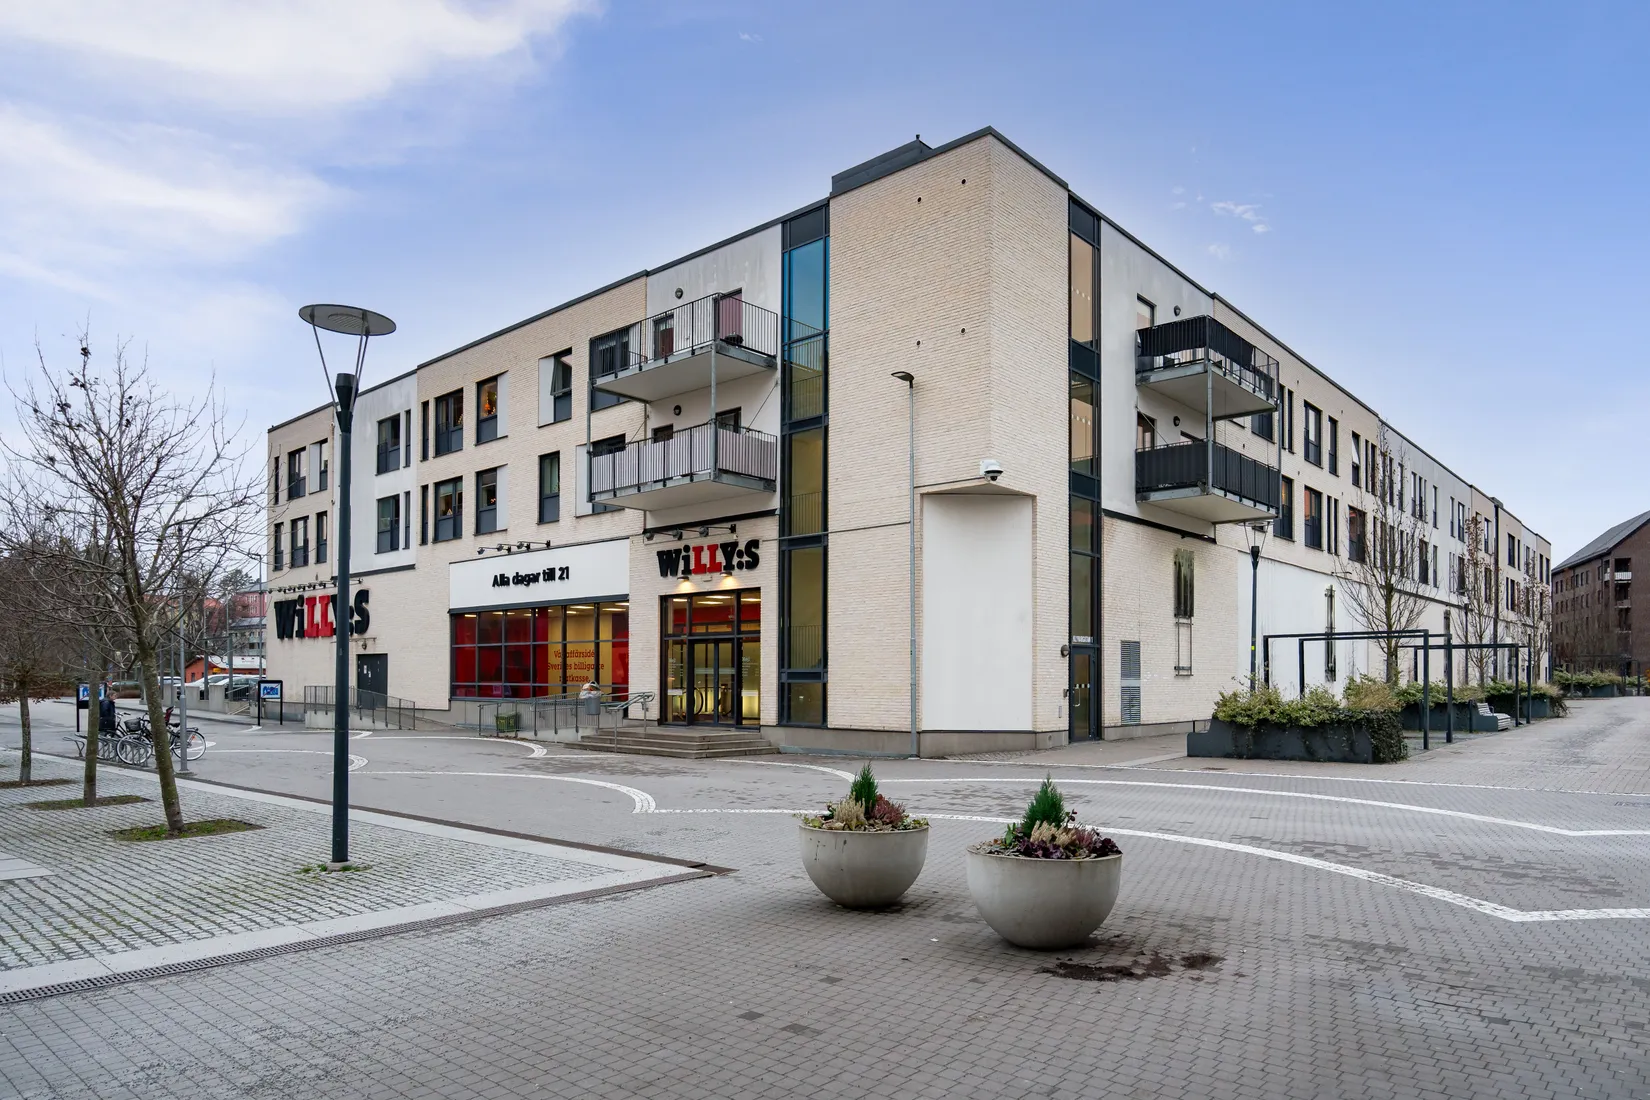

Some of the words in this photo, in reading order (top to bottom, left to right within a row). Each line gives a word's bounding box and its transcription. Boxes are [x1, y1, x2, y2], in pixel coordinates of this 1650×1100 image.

[492, 573, 510, 587] Alla
[512, 571, 541, 587] dagar
[542, 567, 556, 582] till
[558, 566, 570, 580] 21
